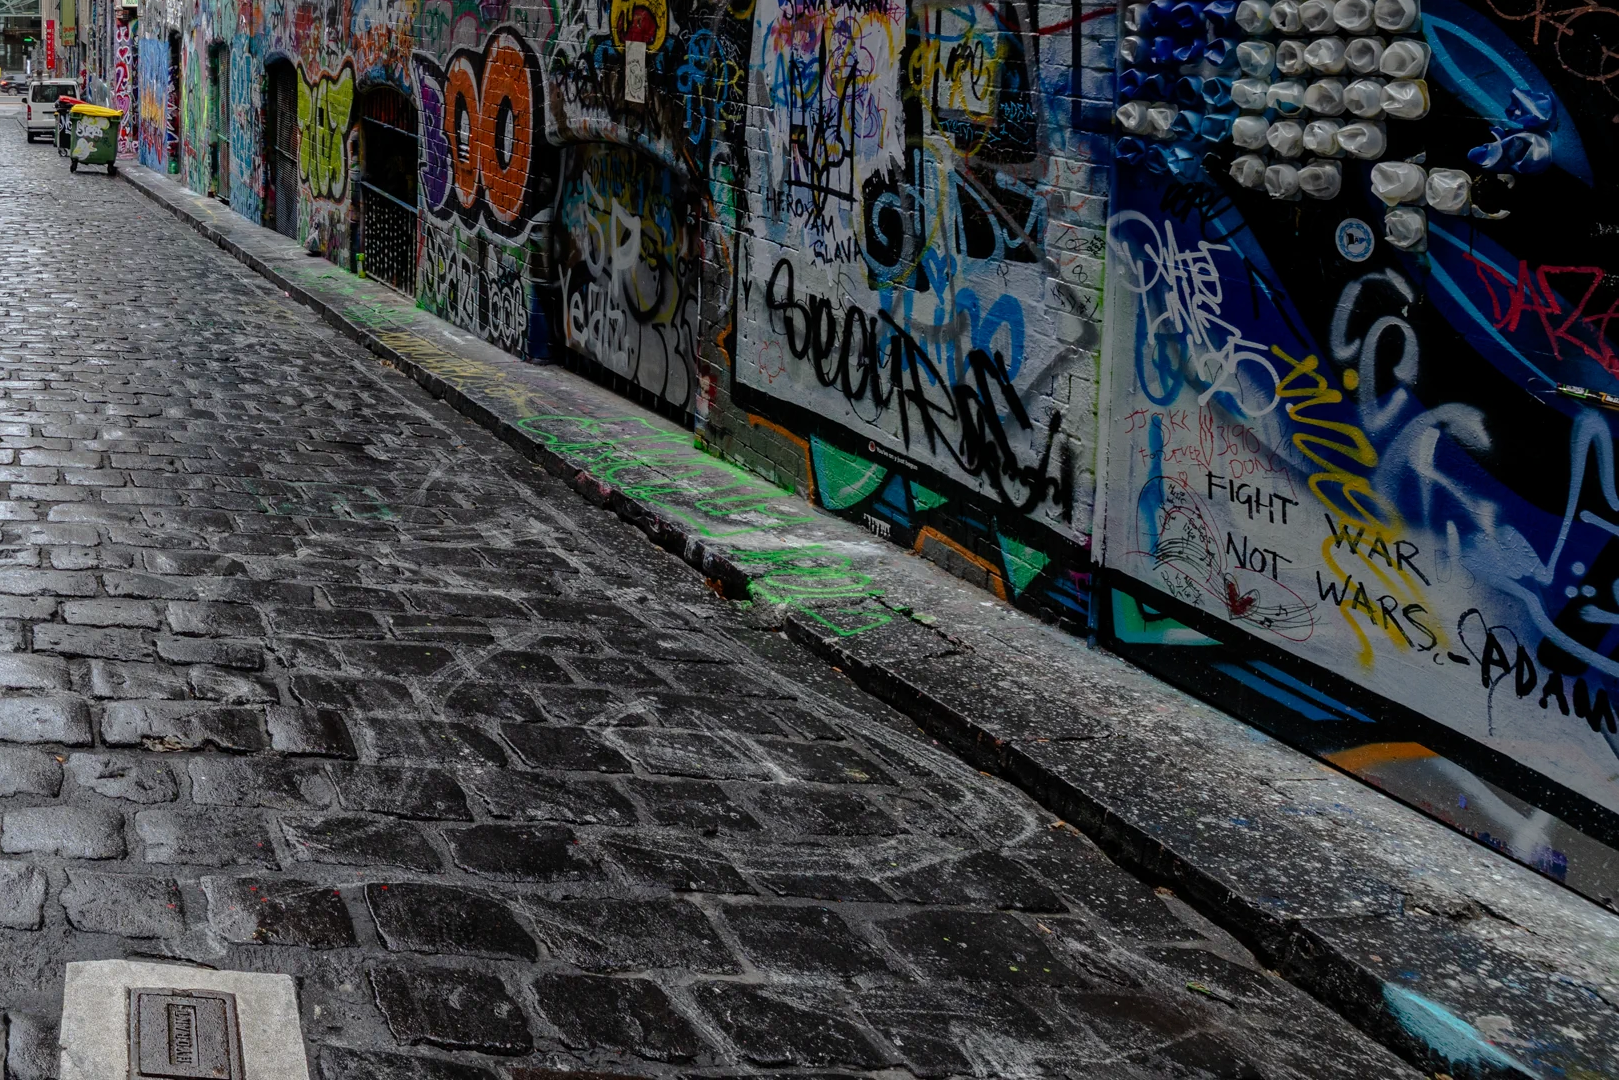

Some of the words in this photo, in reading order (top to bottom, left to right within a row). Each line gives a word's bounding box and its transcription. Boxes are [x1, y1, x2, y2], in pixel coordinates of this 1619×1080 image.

[1205, 471, 1299, 524] FIGHT
[1324, 513, 1432, 586] WAR
[1226, 531, 1292, 580] NOT
[175, 1003, 196, 1066] HYDRANT
